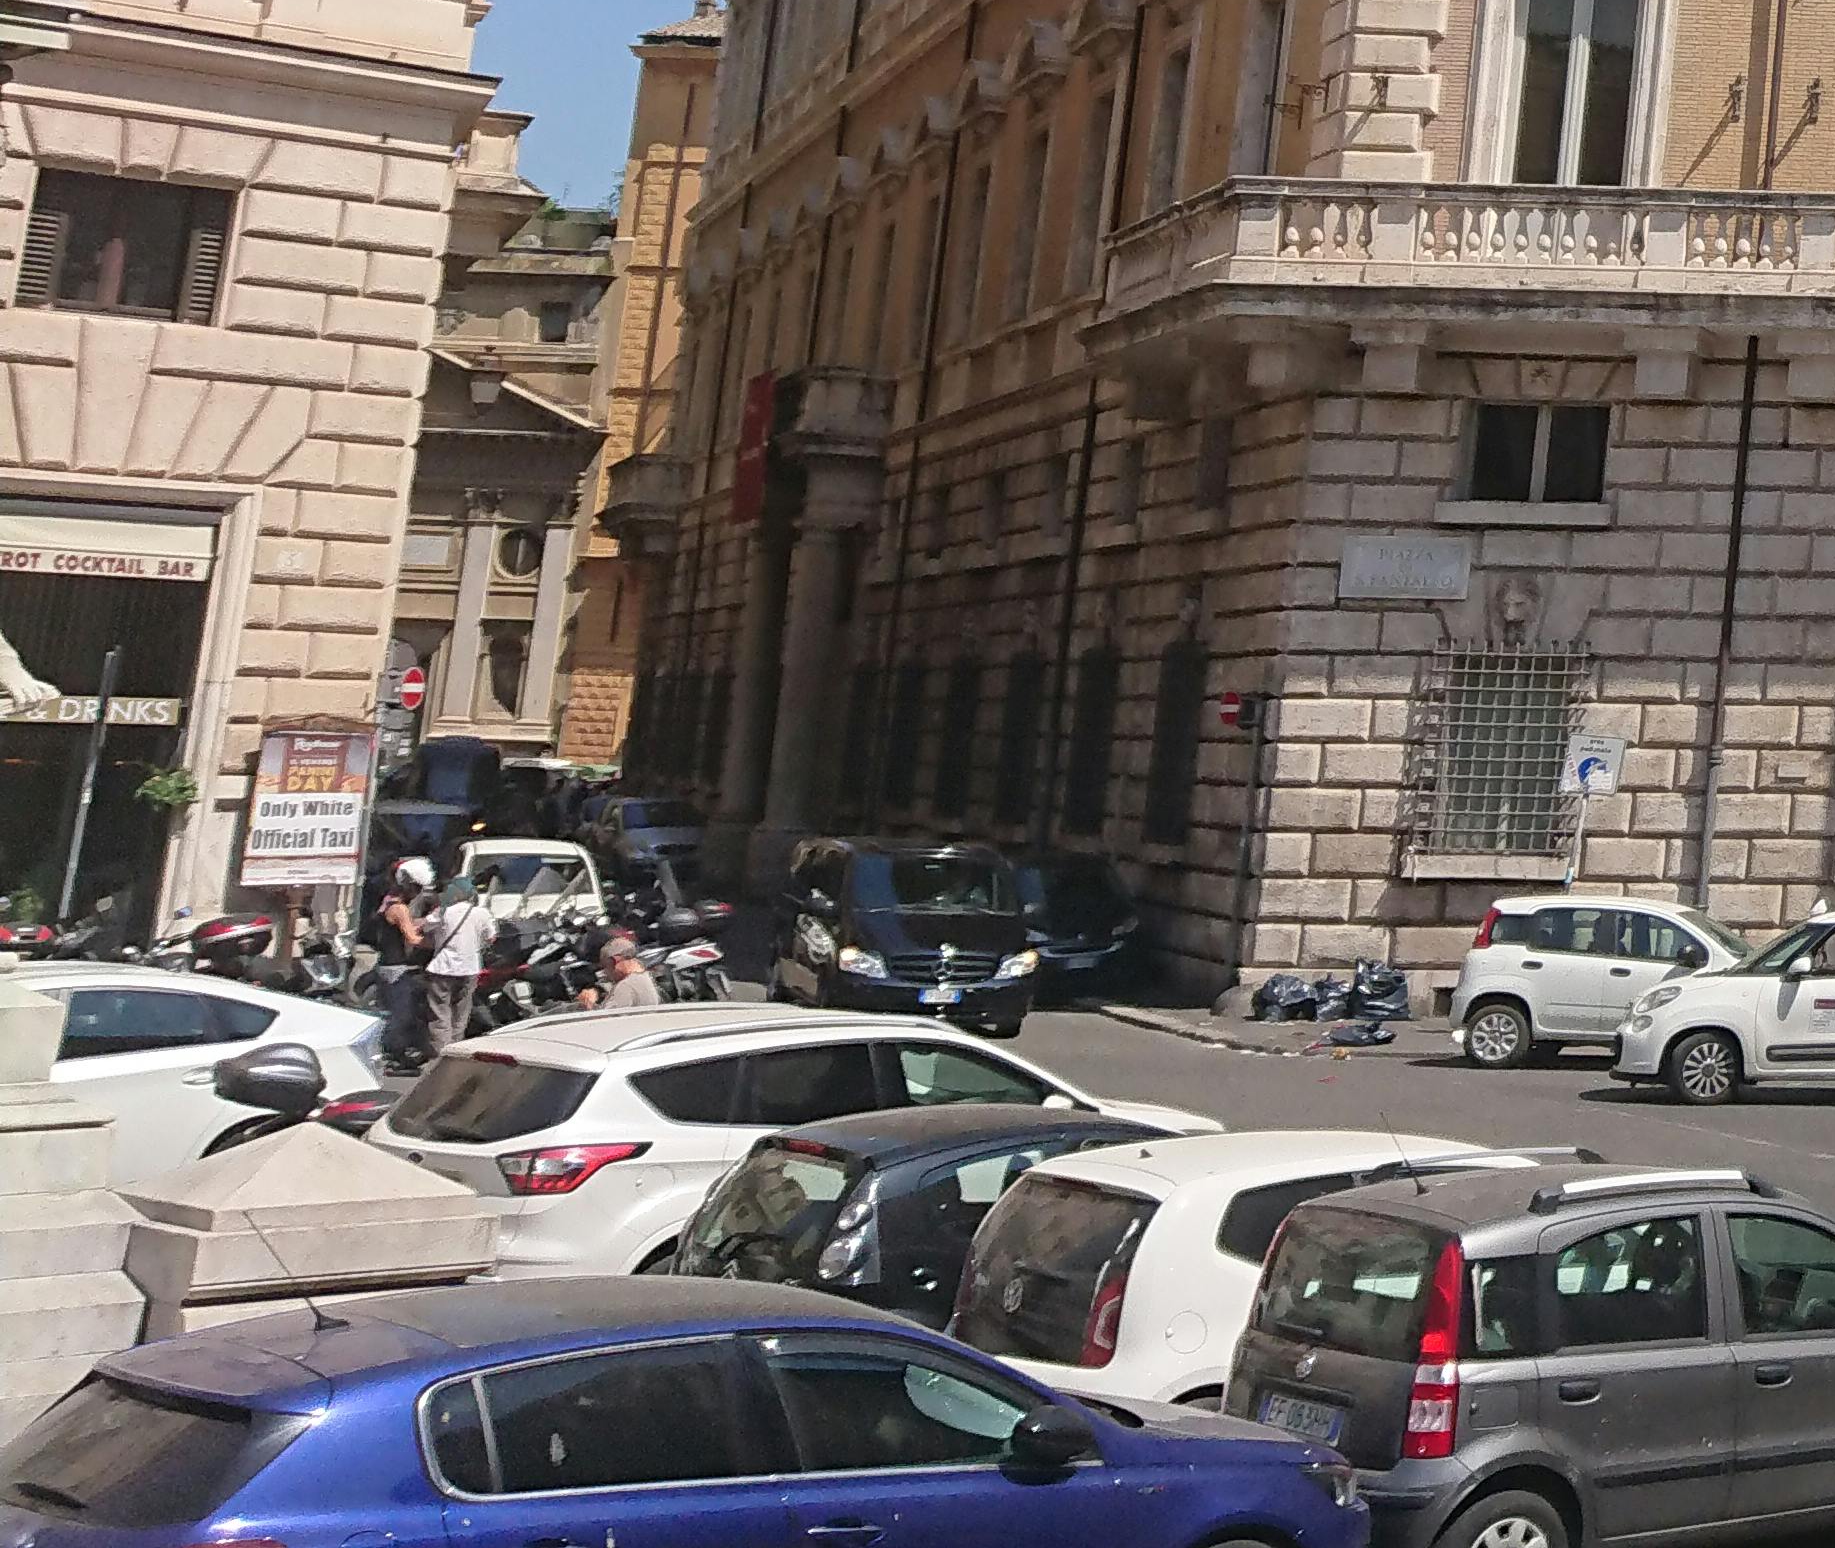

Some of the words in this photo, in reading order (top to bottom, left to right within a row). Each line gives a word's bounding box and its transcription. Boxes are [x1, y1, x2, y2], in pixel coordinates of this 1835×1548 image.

[53, 554, 145, 575] COCKTAIL
[157, 560, 194, 577] BAR
[57, 699, 171, 722] DRNKS
[286, 776, 334, 791] DAY
[260, 801, 297, 818] Only
[302, 799, 354, 816] White
[252, 827, 316, 850] Official
[320, 826, 356, 848] Taxi
